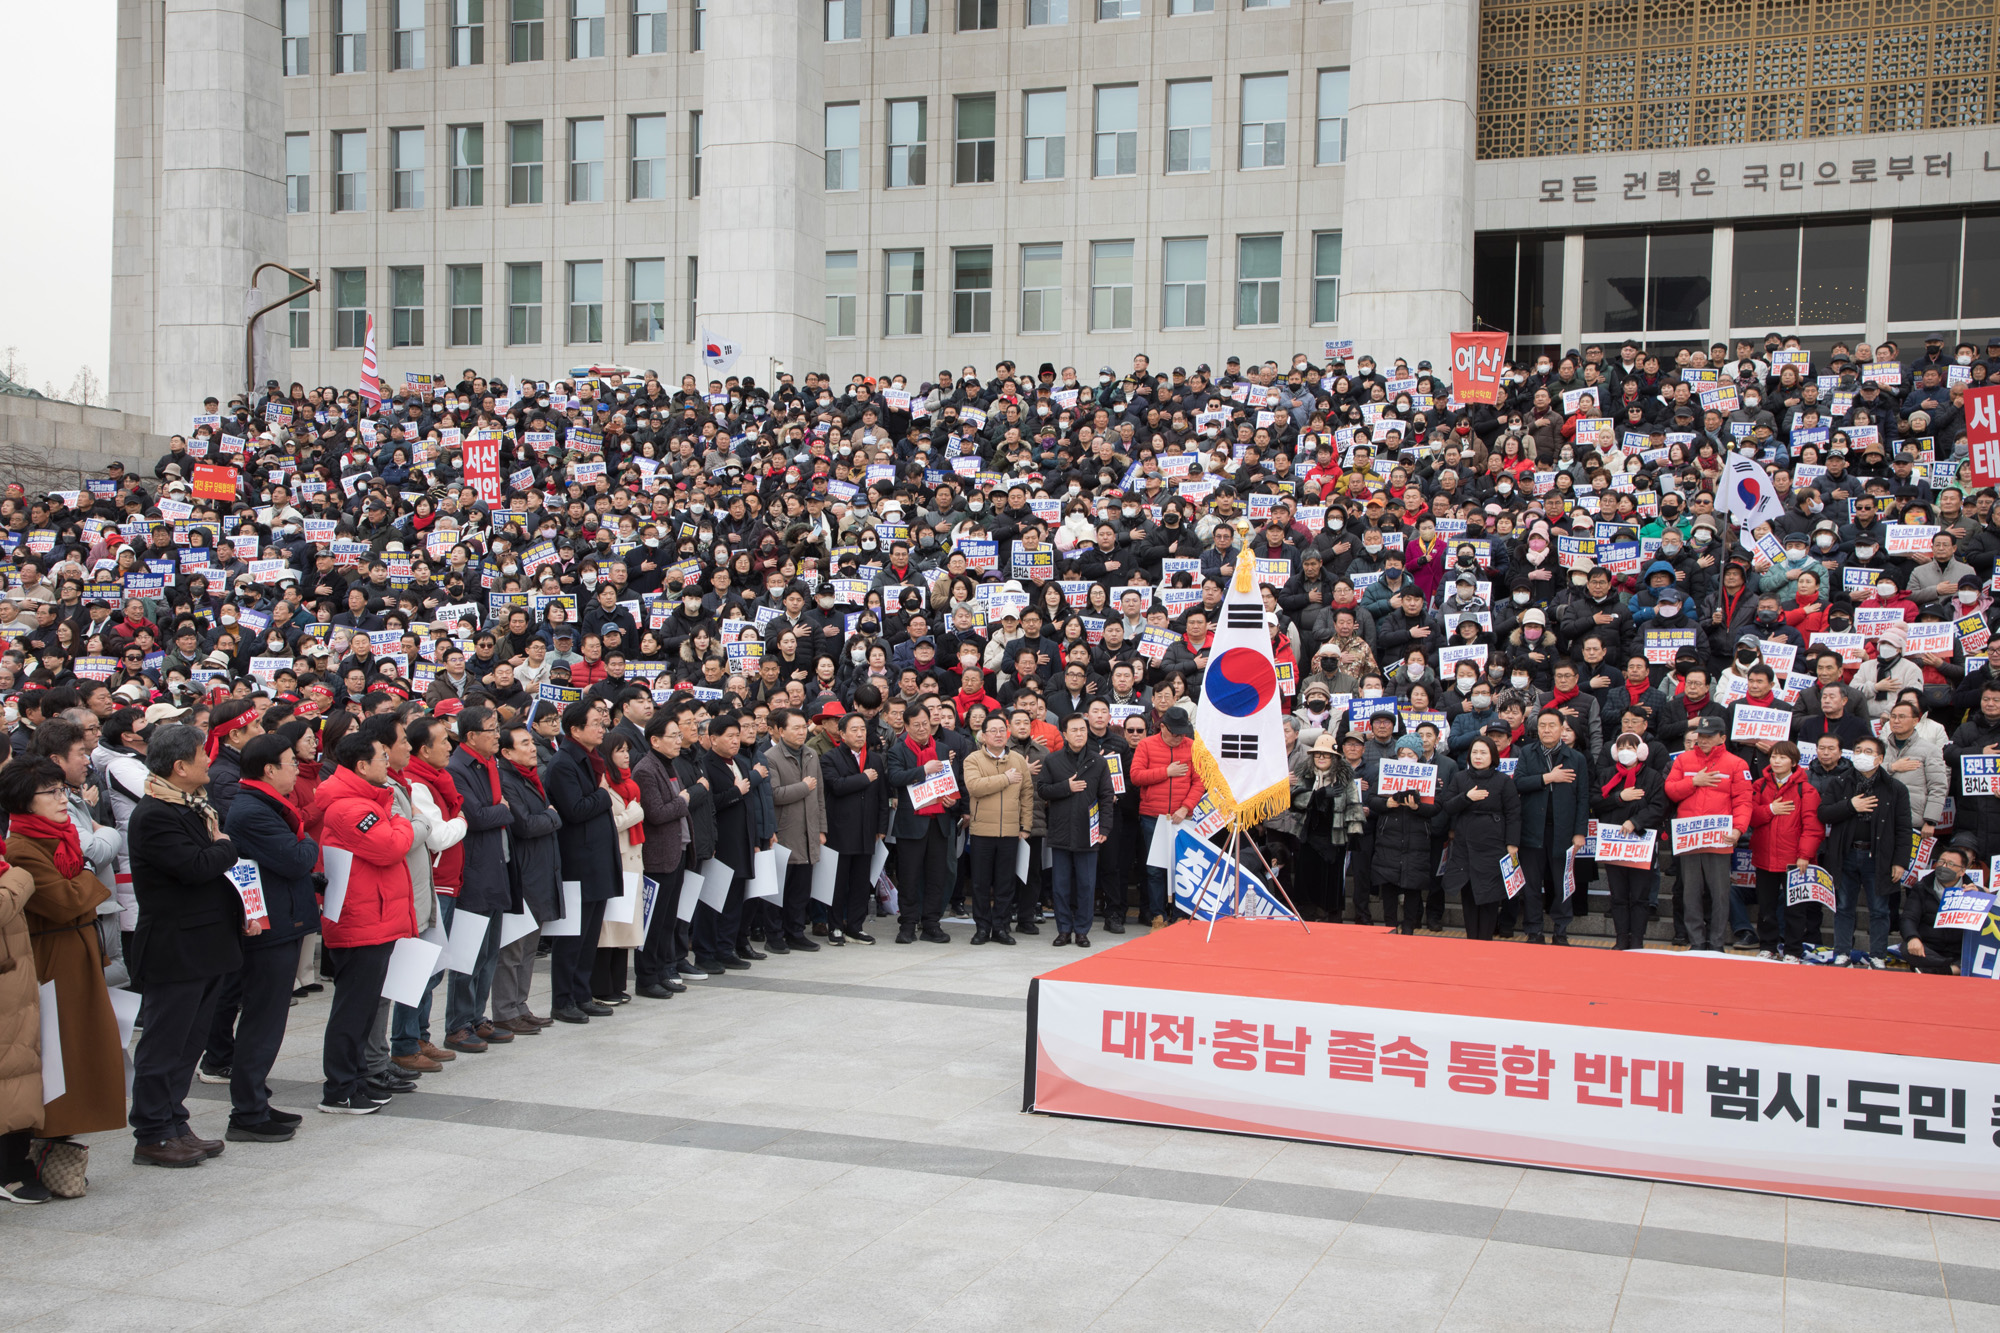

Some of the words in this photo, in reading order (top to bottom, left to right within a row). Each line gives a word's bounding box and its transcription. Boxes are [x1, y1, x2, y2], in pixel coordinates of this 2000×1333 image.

[1539, 176, 1597, 202] 모든
[1623, 169, 1716, 200] 권력은
[1744, 152, 1952, 192] 국민으로부터
[1455, 346, 1502, 383] 예산
[1970, 394, 2000, 434] 서
[466, 445, 497, 473] 서산
[1889, 539, 1909, 551] 결사
[1559, 553, 1574, 567] 결사
[1599, 546, 1637, 563] 강제합병
[127, 577, 163, 588] 강제합병
[127, 588, 162, 598] 결사반대
[438, 610, 456, 620] 공천
[1924, 635, 1949, 651] 반대!
[1647, 650, 1677, 661] 중단하
[1766, 657, 1790, 671] 반대!
[236, 708, 258, 725] 결사반
[1354, 721, 1372, 732] 결사
[1736, 722, 1757, 737] 결사
[1759, 723, 1786, 738] 반대!
[1383, 764, 1408, 774] 충남·대전
[1965, 759, 1983, 774] 주민
[1984, 758, 1994, 773] 뜻
[1382, 777, 1403, 790] 결사
[1406, 778, 1431, 793] 반대!
[1965, 777, 1988, 793] 정치쇼
[913, 786, 933, 802] 정치쇼
[1676, 819, 1702, 833] 충남·대전
[1677, 833, 1699, 850] 결사
[1599, 843, 1622, 857] 결사
[1625, 843, 1649, 858] 반대!
[1789, 885, 1810, 903] 정치쇼
[1942, 896, 1990, 911] 강제합병
[1937, 912, 1982, 926] 결사반대
[1101, 1009, 1312, 1077] 대전·충남
[1327, 1028, 1429, 1089] 졸속
[1447, 1039, 1555, 1101] 통합
[1573, 1053, 1685, 1115] 반대
[1705, 1065, 1968, 1145] 범시·도민
